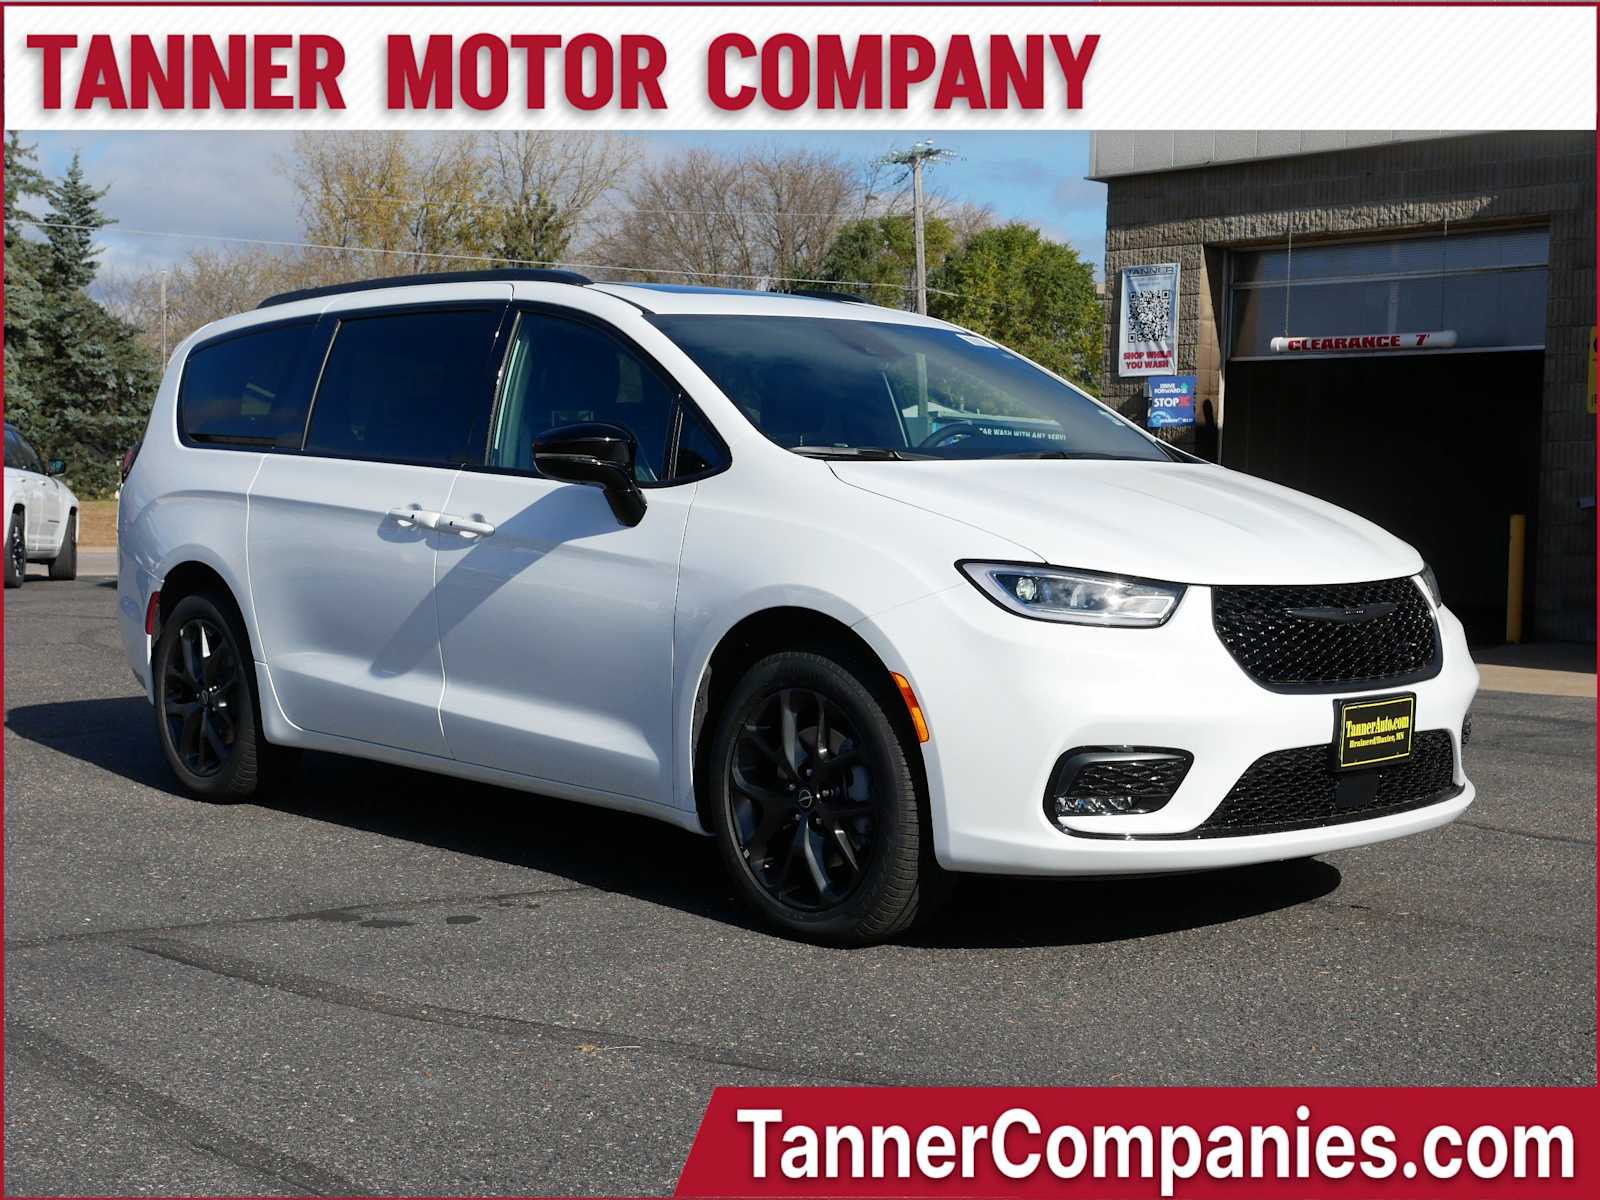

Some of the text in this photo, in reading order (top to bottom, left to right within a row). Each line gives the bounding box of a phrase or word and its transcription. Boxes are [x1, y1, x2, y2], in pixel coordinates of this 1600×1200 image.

[1288, 334, 1430, 351] CLEARANCE 7'
[1123, 351, 1144, 360] SHOP
[1126, 360, 1169, 369] YOU WASH
[1154, 397, 1179, 407] STOP
[993, 428, 1012, 436] WASH
[1031, 431, 1046, 439] ANY
[1346, 716, 1409, 737] TannerAuto.com
